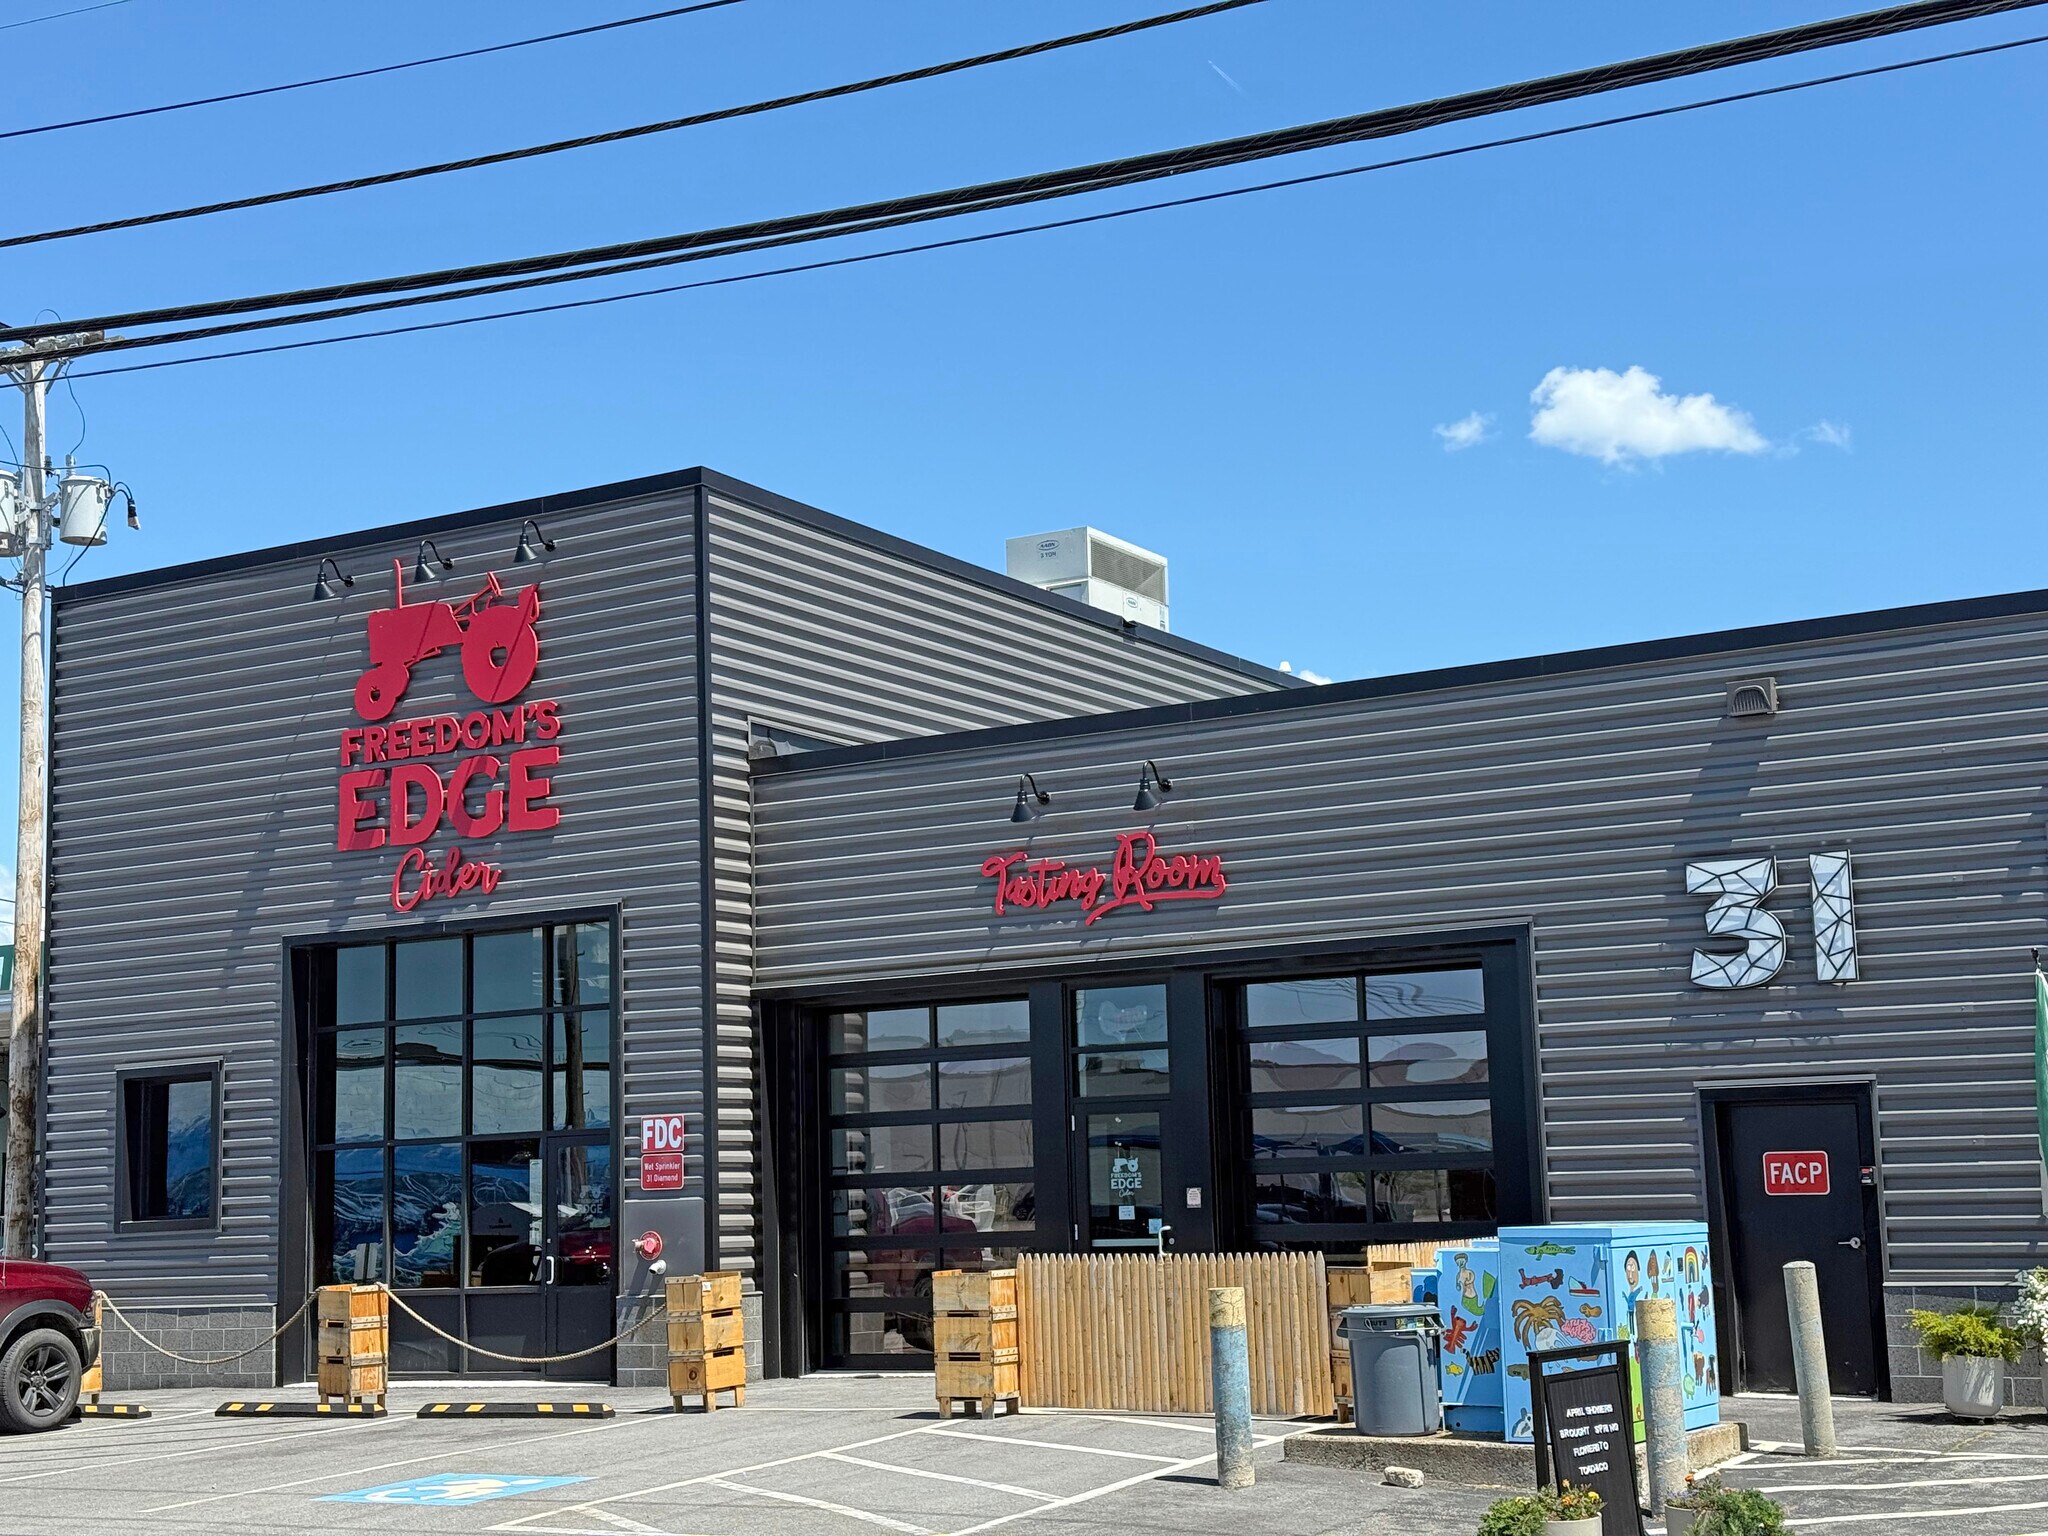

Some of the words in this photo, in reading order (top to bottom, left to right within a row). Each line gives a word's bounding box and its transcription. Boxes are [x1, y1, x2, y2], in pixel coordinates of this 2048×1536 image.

[340, 701, 561, 767] FREEDOM'S
[337, 746, 560, 852] EDGE
[391, 847, 501, 912] Cider
[981, 852, 1106, 916] Tasting
[1086, 832, 1226, 926] Room
[1685, 849, 1859, 990] 31
[642, 1117, 682, 1150] FDC
[644, 1163, 654, 1171] Wet
[655, 1161, 681, 1172] Sprinkler
[646, 1174, 653, 1183] 31
[653, 1173, 679, 1183] Diamond
[1769, 1161, 1823, 1185] FACP
[1111, 1178, 1142, 1189] EDGE
[1566, 1407, 1585, 1418] APRIL
[1559, 1426, 1590, 1439] BROUGHT
